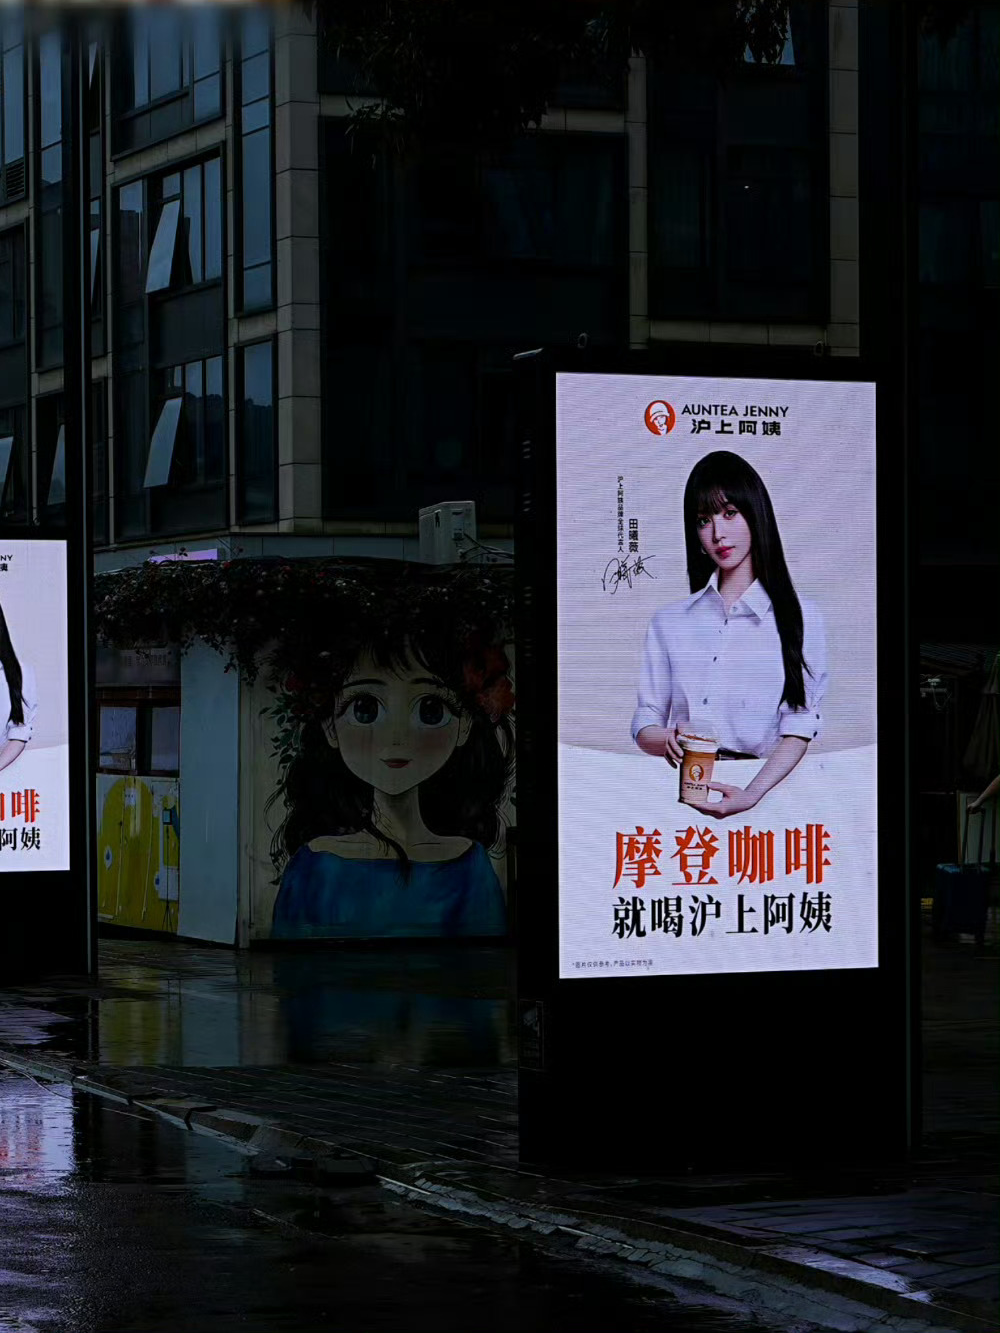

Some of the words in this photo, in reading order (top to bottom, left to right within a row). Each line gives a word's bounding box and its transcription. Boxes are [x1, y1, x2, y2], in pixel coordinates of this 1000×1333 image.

[681, 404, 738, 416] AUNTEA
[743, 405, 789, 418] JENNY
[690, 419, 781, 436] 沪上阿姨
[612, 823, 833, 889] 摩登咖啡
[612, 891, 833, 939] 就喝沪上阿姨
